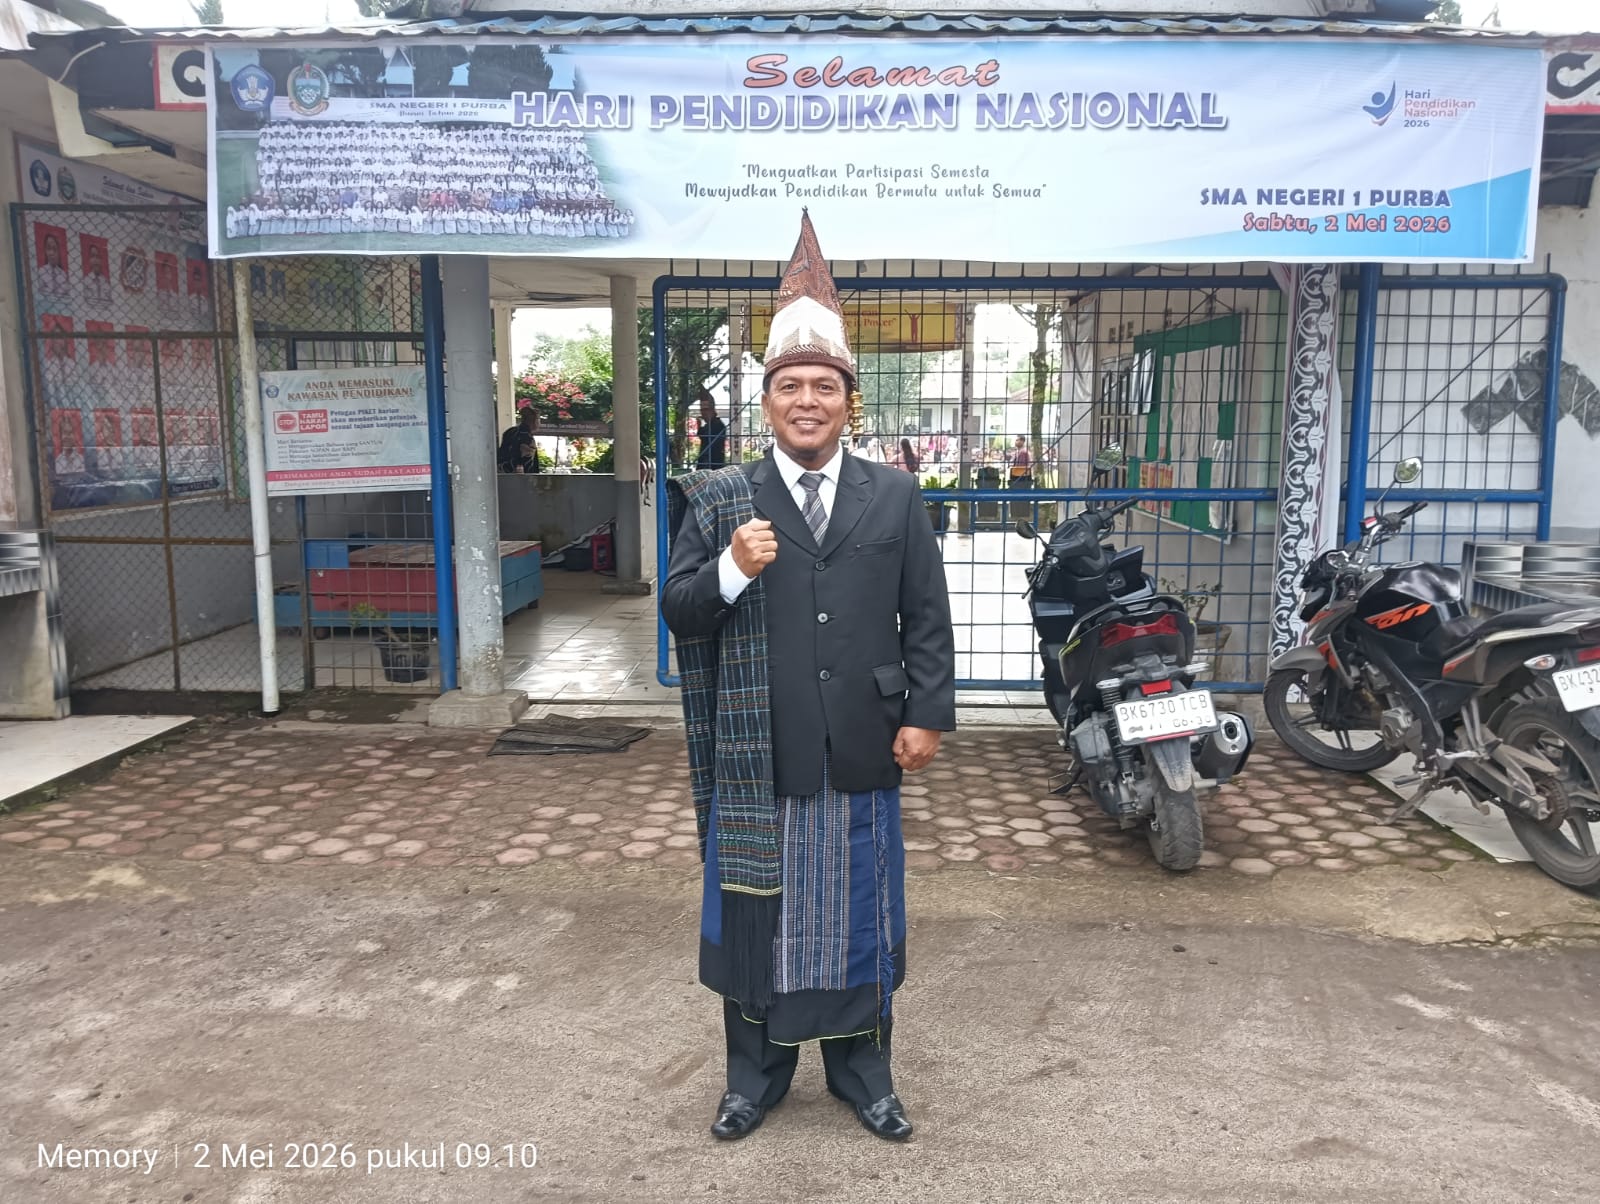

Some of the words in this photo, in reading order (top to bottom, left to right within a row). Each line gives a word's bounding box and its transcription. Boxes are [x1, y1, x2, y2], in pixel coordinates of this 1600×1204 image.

[743, 53, 1001, 89] Selamat
[1404, 89, 1431, 101] Hari
[1404, 98, 1476, 110] Pendidikan
[510, 90, 634, 130] HARI
[649, 93, 960, 131] PENDIDIKAN
[975, 91, 1228, 131] NASIONAL
[1404, 107, 1458, 118] Nasional
[1404, 119, 1430, 128] 2026
[845, 164, 924, 182] Partisipasi
[930, 164, 990, 179] Semesta
[685, 183, 777, 202] Mewujudkan
[785, 183, 868, 198] Pendidikan
[876, 183, 937, 199] Bermutu
[945, 183, 985, 198] untuk
[1200, 188, 1247, 206] SMA
[1256, 188, 1344, 206] NEGERI
[1352, 189, 1361, 206] 1
[1370, 189, 1451, 207] PURBA
[1242, 212, 1317, 234] Sabtu,
[1324, 214, 1339, 232] 2
[1346, 213, 1386, 233] Mei
[1394, 213, 1451, 233] 2026
[304, 380, 333, 390] ANDA
[337, 378, 394, 389] MEMASUKI
[287, 391, 338, 402] KAWASAN
[342, 387, 414, 399] PENDIDIKAN!
[1180, 694, 1208, 712] TCB
